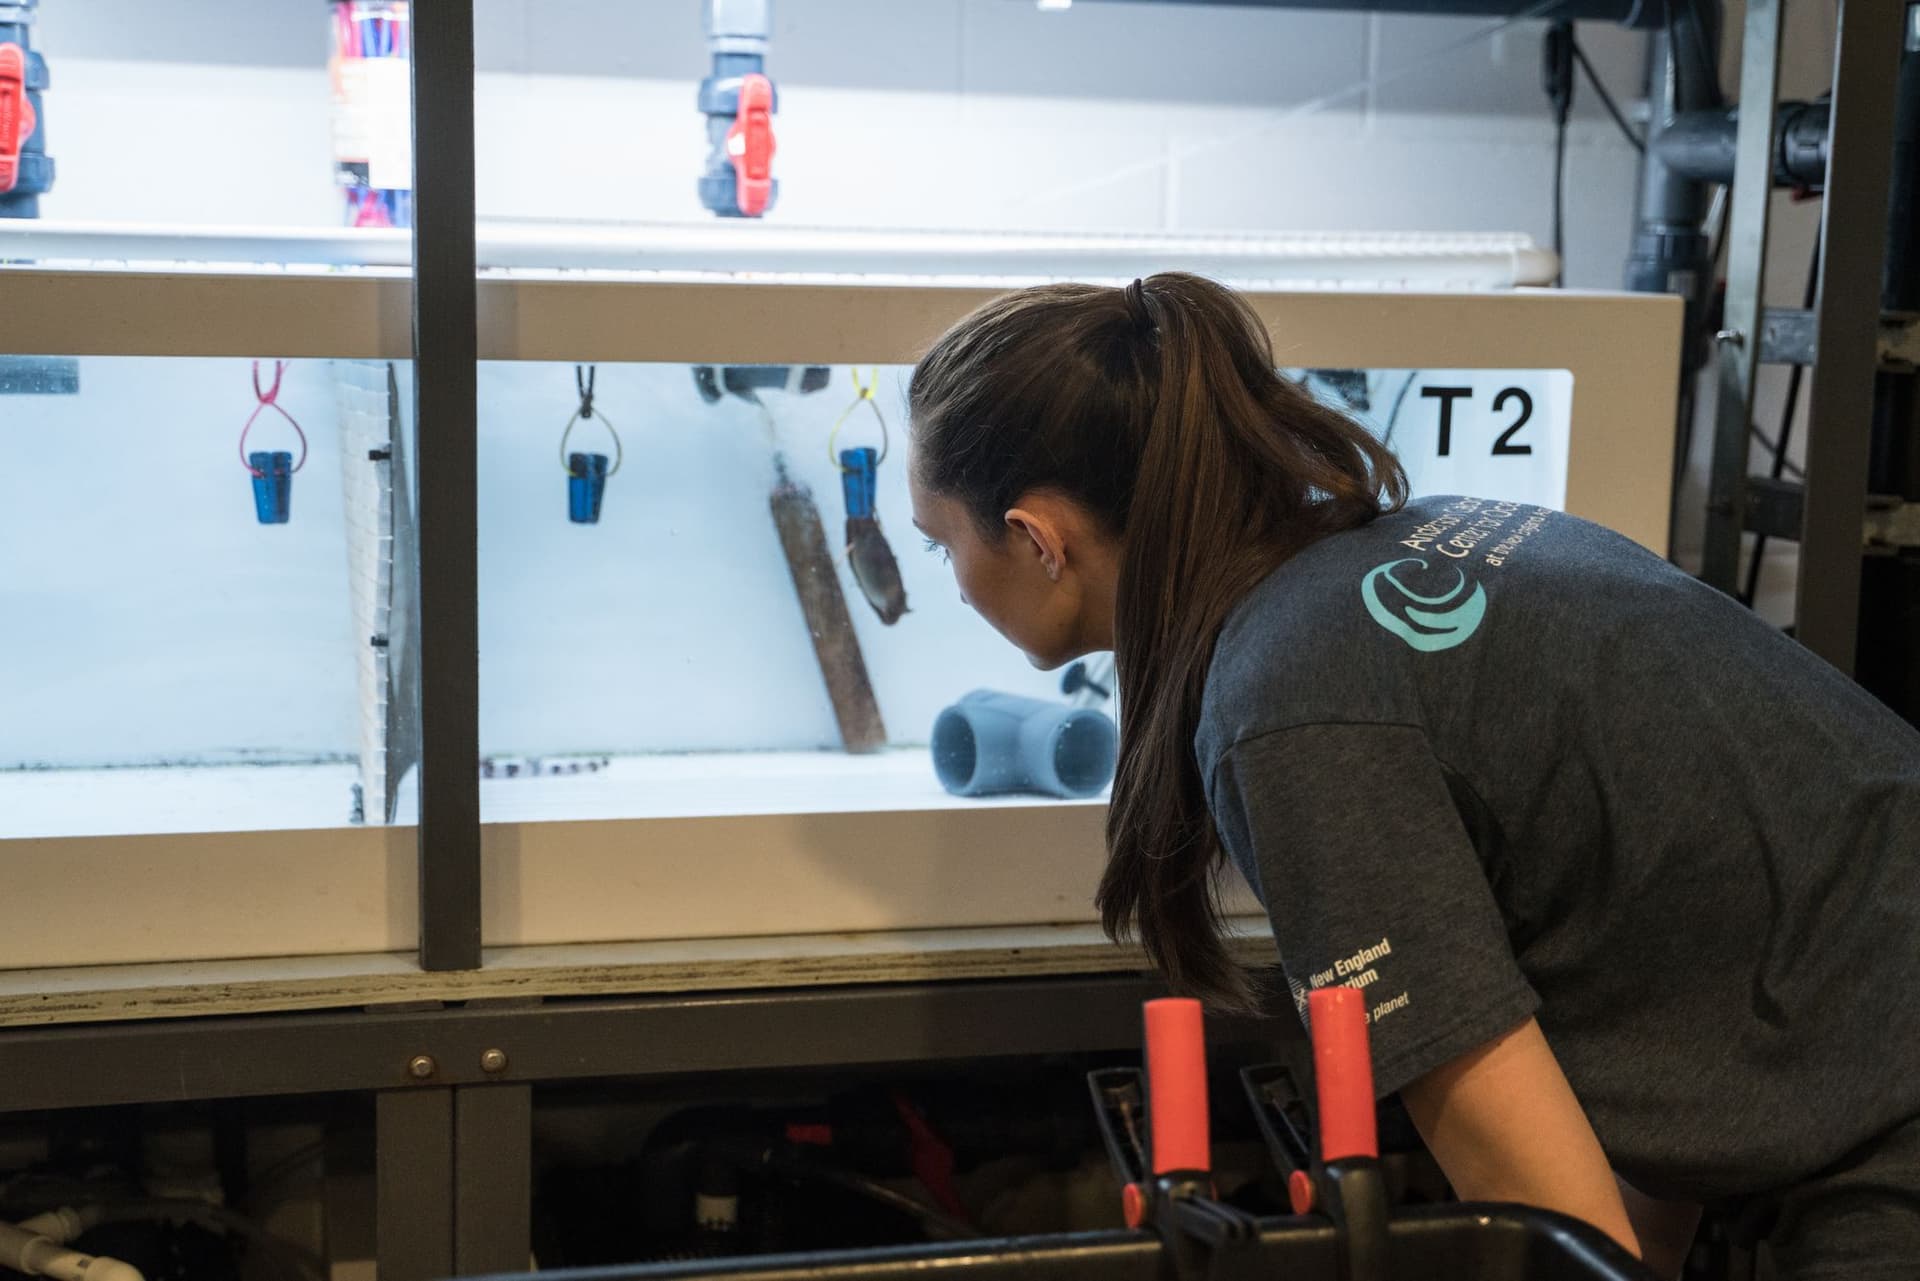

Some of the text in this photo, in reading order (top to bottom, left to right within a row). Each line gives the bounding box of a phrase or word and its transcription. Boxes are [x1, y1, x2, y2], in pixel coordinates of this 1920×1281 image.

[1421, 386, 1533, 457] T 2
[1436, 526, 1488, 558] Center
[1485, 553, 1505, 567] at
[1310, 937, 1392, 989] New England
[1338, 968, 1379, 989] rium
[1373, 991, 1409, 1023] planet
